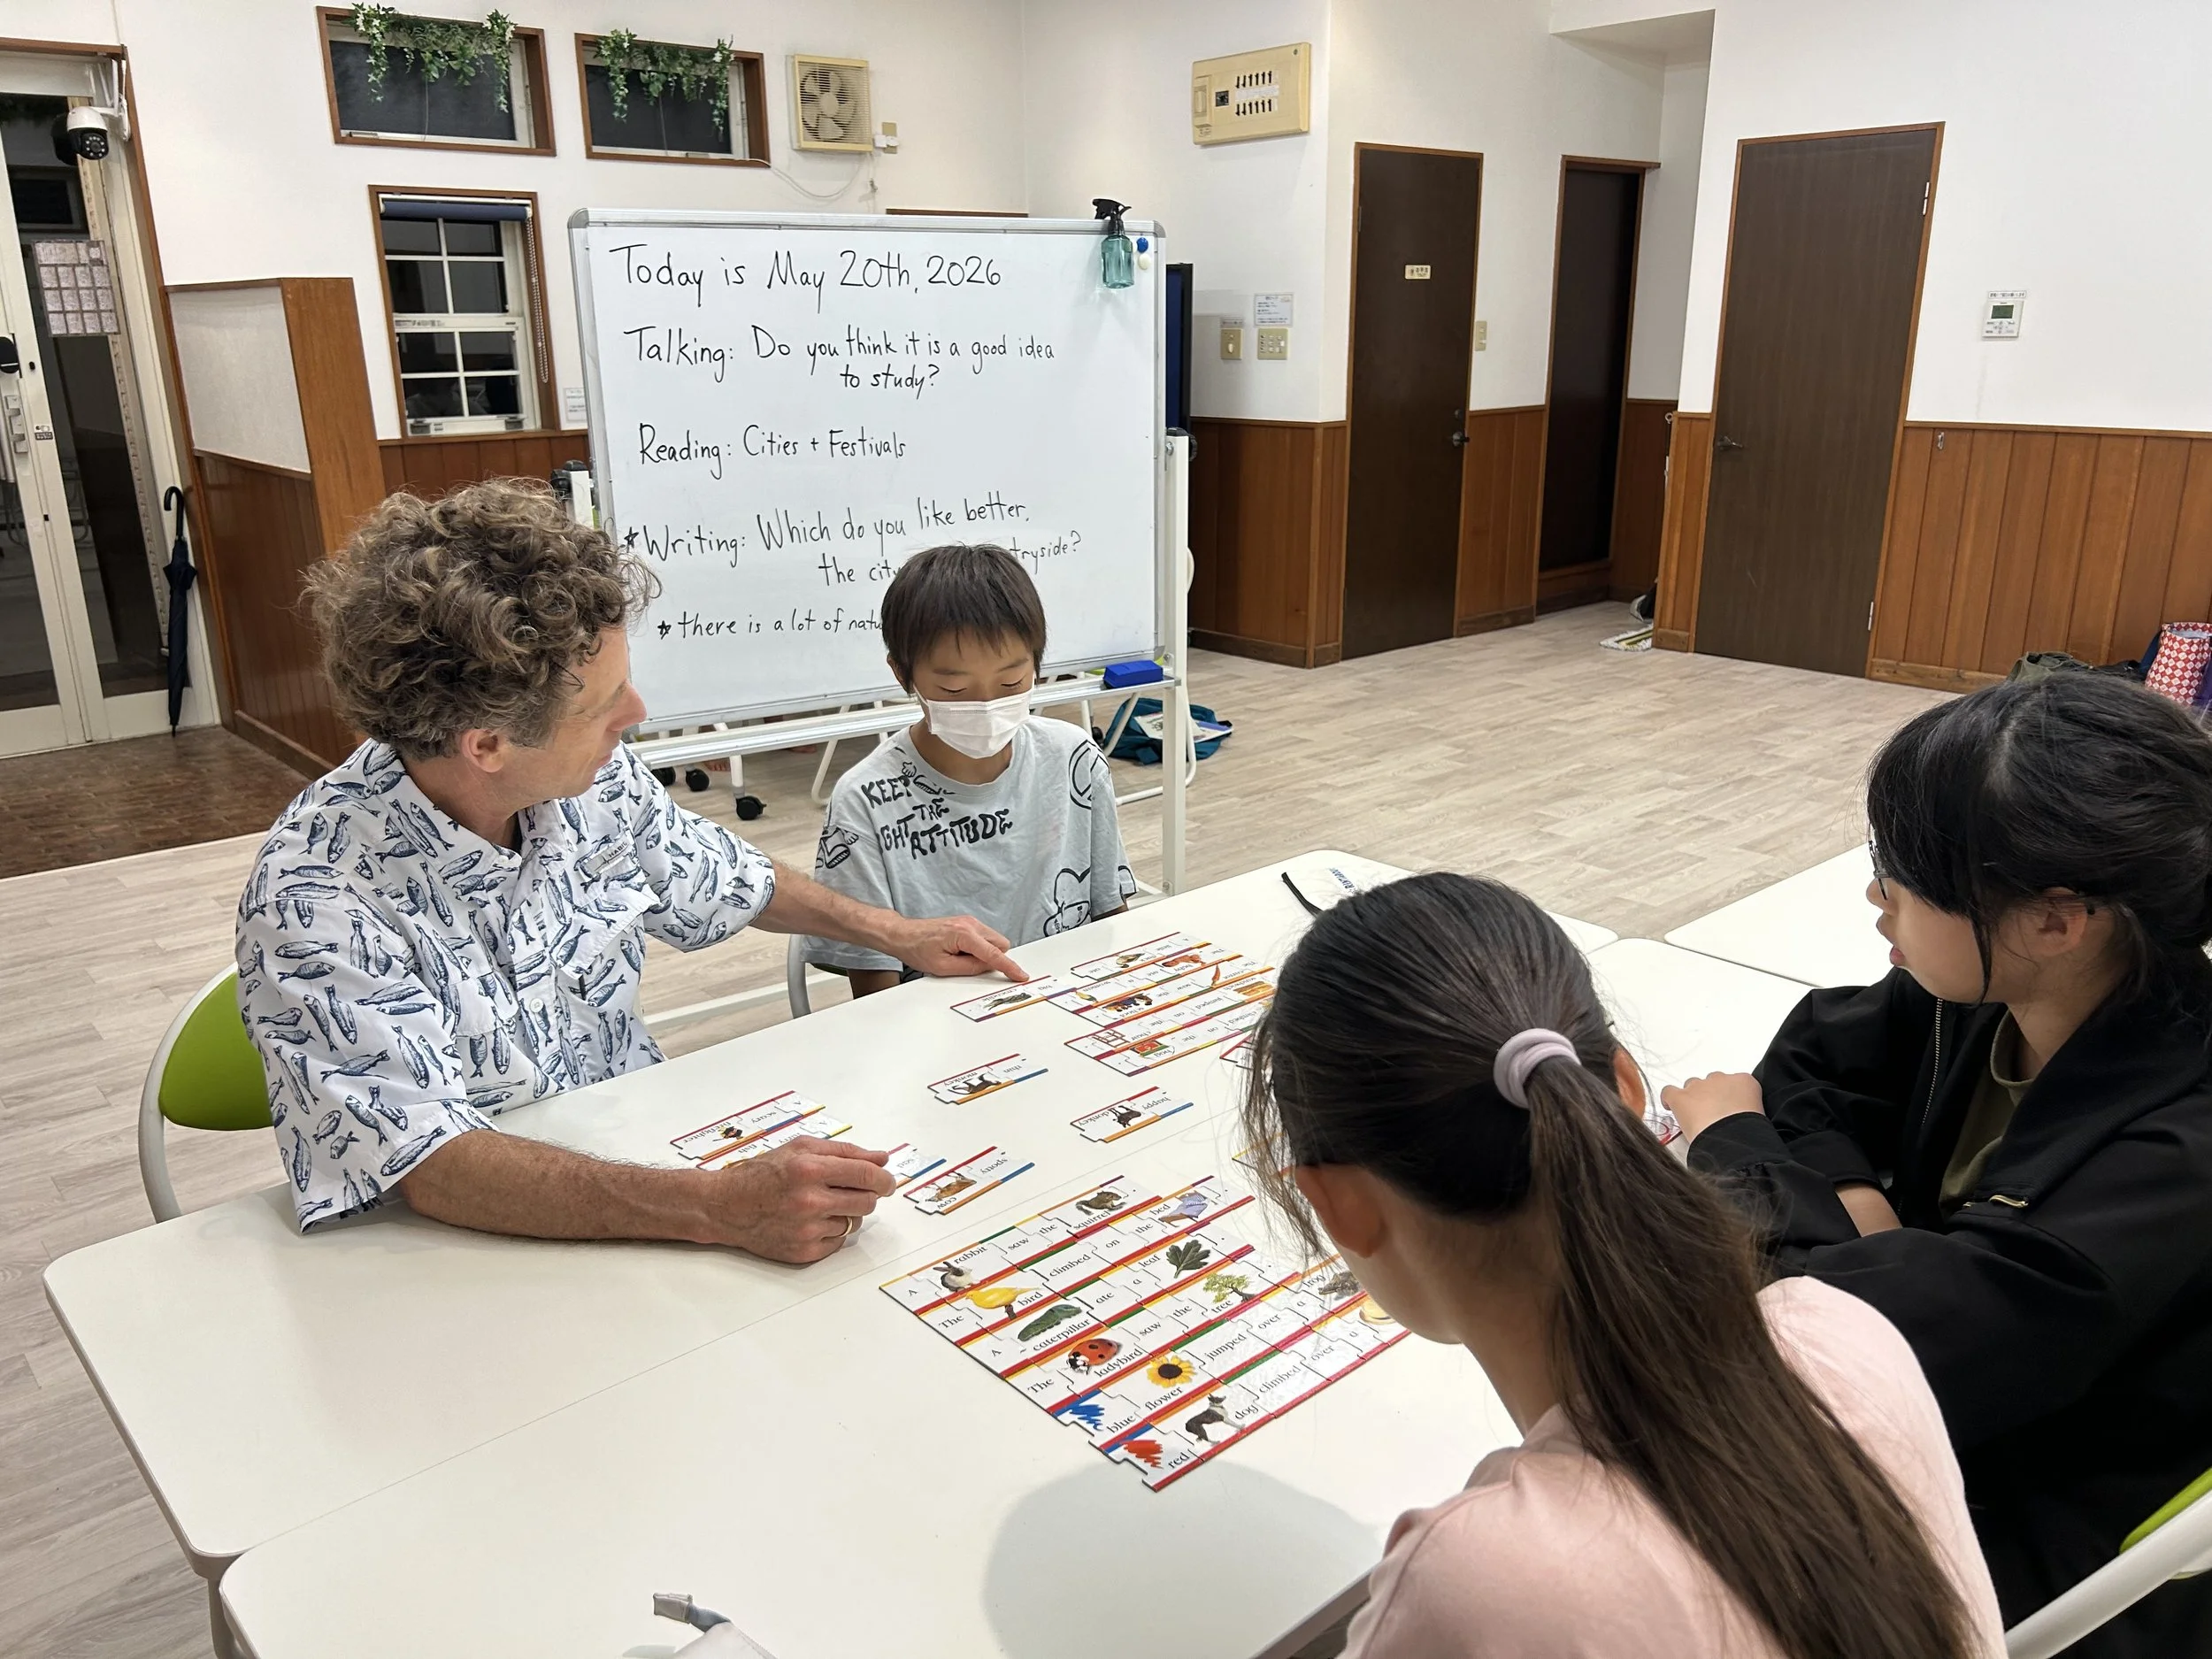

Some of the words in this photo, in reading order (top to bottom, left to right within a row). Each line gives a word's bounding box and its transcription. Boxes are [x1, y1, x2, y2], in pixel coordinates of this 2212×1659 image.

[608, 243, 704, 309] Today
[720, 257, 746, 287] is
[766, 250, 826, 315] May
[926, 255, 1002, 287] 2026
[622, 325, 733, 384] Talking:
[750, 324, 791, 359] Do
[806, 342, 840, 376] you
[845, 323, 898, 357] think
[904, 330, 921, 357] it
[927, 332, 941, 357] is
[949, 342, 961, 357] a
[971, 334, 1008, 375] good
[1018, 334, 1055, 360] idea
[839, 363, 861, 388] to
[870, 363, 941, 401] study?
[638, 422, 732, 480] Reading:
[742, 424, 799, 457] Cities
[810, 437, 820, 452] +
[828, 425, 907, 459] Festivals
[642, 524, 746, 569] Writing:
[756, 507, 832, 551] Which
[841, 506, 865, 541] do
[873, 518, 907, 557] you
[917, 496, 956, 530] like
[817, 552, 856, 587] the
[1008, 529, 1083, 576] tryside?
[677, 611, 737, 640] there
[748, 613, 762, 634] is
[773, 619, 785, 632] a
[791, 608, 817, 632] lot
[823, 607, 845, 634] of
[848, 609, 883, 632] natu
[861, 775, 912, 809] KEEP
[912, 797, 949, 821] THE
[879, 813, 916, 851] GHT
[910, 808, 1014, 860] ATTITUDE
[943, 1071, 978, 1087] monkey
[1002, 1064, 1022, 1074] thin
[1078, 1110, 1110, 1126] donkey
[1141, 1097, 1171, 1110] happy
[682, 1121, 732, 1143] firefighter
[737, 1144, 757, 1155] fish
[980, 1157, 1008, 1175] spotty
[936, 1196, 957, 1210] cow
[908, 1287, 918, 1296] A
[953, 1244, 988, 1266] rabbit
[1007, 1236, 1030, 1251] saw
[1039, 1221, 1059, 1236] the
[1072, 1210, 1111, 1232] squirrel
[940, 1314, 964, 1330] The
[1018, 1291, 1043, 1309] bird
[1048, 1253, 1091, 1278] climbed
[1105, 1237, 1120, 1248] on
[1134, 1222, 1154, 1235] the
[1149, 1203, 1171, 1217] bed
[990, 1348, 1002, 1358] A
[1032, 1317, 1092, 1353] caterpillar
[1094, 1291, 1115, 1305] ate
[1133, 1277, 1142, 1286] a
[1138, 1254, 1162, 1269] leaf
[1028, 1377, 1055, 1395] The
[1094, 1348, 1144, 1378] ladybird
[1139, 1320, 1163, 1336] saw
[1172, 1303, 1193, 1318] the
[1210, 1299, 1234, 1315] tree
[1107, 1413, 1137, 1435] blue
[1143, 1385, 1184, 1412] flower
[1205, 1333, 1248, 1361] jumped
[1257, 1313, 1281, 1330] over
[1167, 1451, 1190, 1470] red
[1234, 1402, 1259, 1420] dog
[1258, 1364, 1302, 1394] climbed
[1310, 1344, 1335, 1362] over
